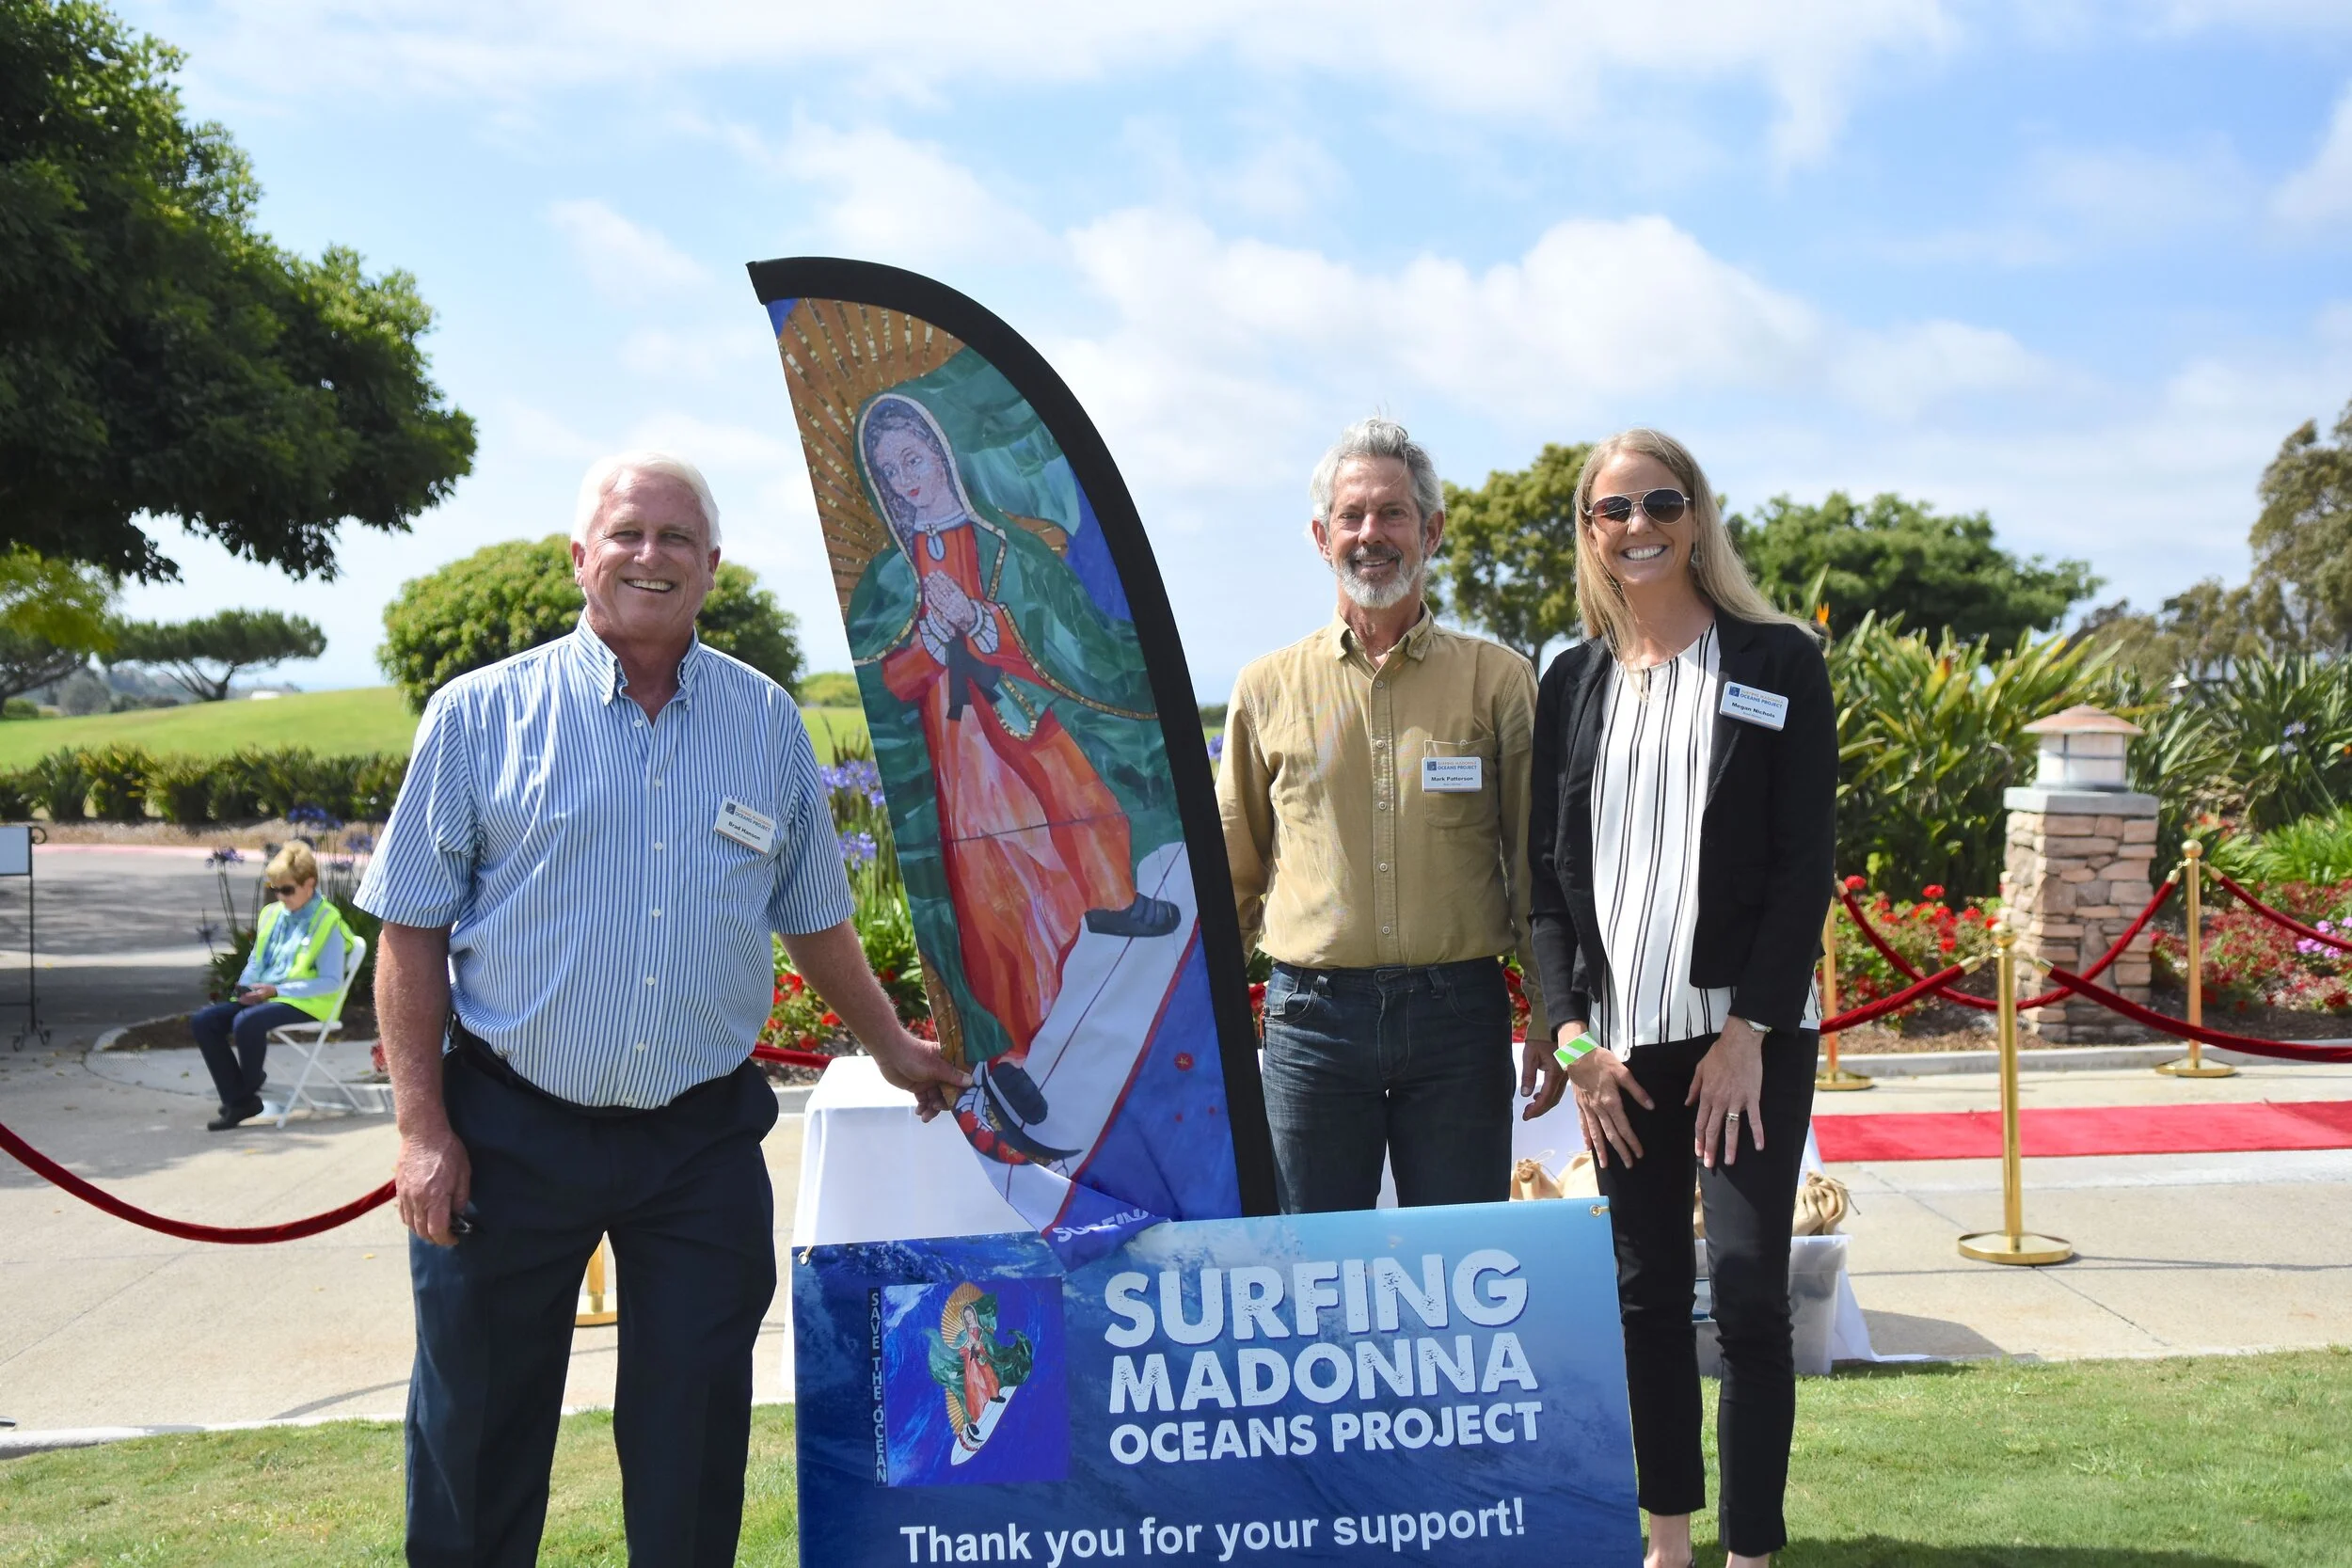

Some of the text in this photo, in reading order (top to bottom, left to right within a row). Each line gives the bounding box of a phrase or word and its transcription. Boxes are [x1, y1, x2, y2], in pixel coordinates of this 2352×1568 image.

[1731, 702, 1752, 712] Megan
[1753, 708, 1775, 718] Nichols
[1740, 693, 1783, 708] OCEANS PROJECT
[728, 820, 741, 831] Brad
[741, 827, 761, 841] Hanson
[735, 811, 771, 832] OCEANS PROJECT
[1104, 1249, 1527, 1347] SURFING
[869, 1292, 888, 1483] SAVE THE OCEAN
[1107, 1332, 1539, 1414] MADONNA
[1109, 1402, 1543, 1465] OCEANS PROJECT
[899, 1497, 1526, 1568] Thank you for your support!
